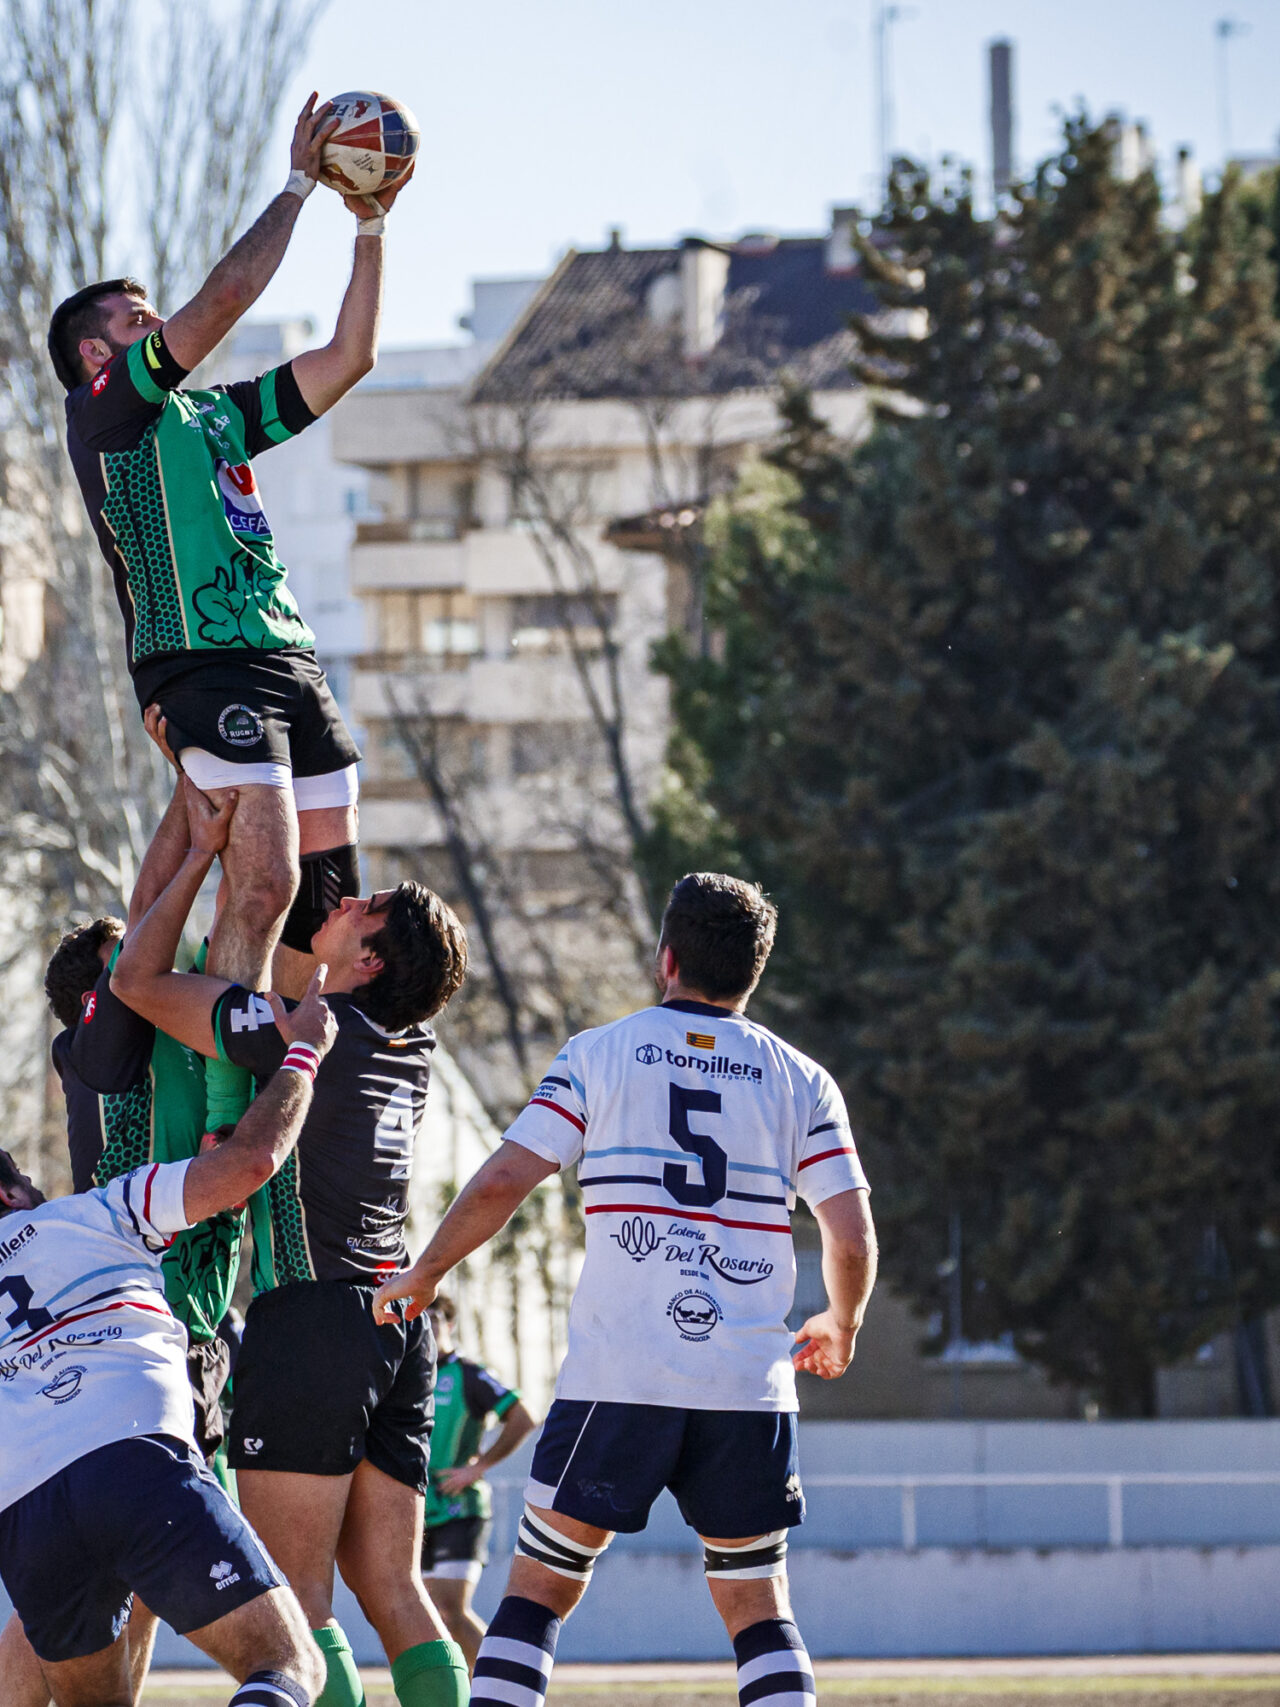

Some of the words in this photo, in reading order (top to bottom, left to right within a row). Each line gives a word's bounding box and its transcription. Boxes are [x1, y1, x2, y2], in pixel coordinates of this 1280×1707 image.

[665, 1049, 763, 1080] tornillera
[662, 1082, 728, 1208] 5
[665, 1244, 695, 1262] Del
[698, 1244, 774, 1285] Rosario
